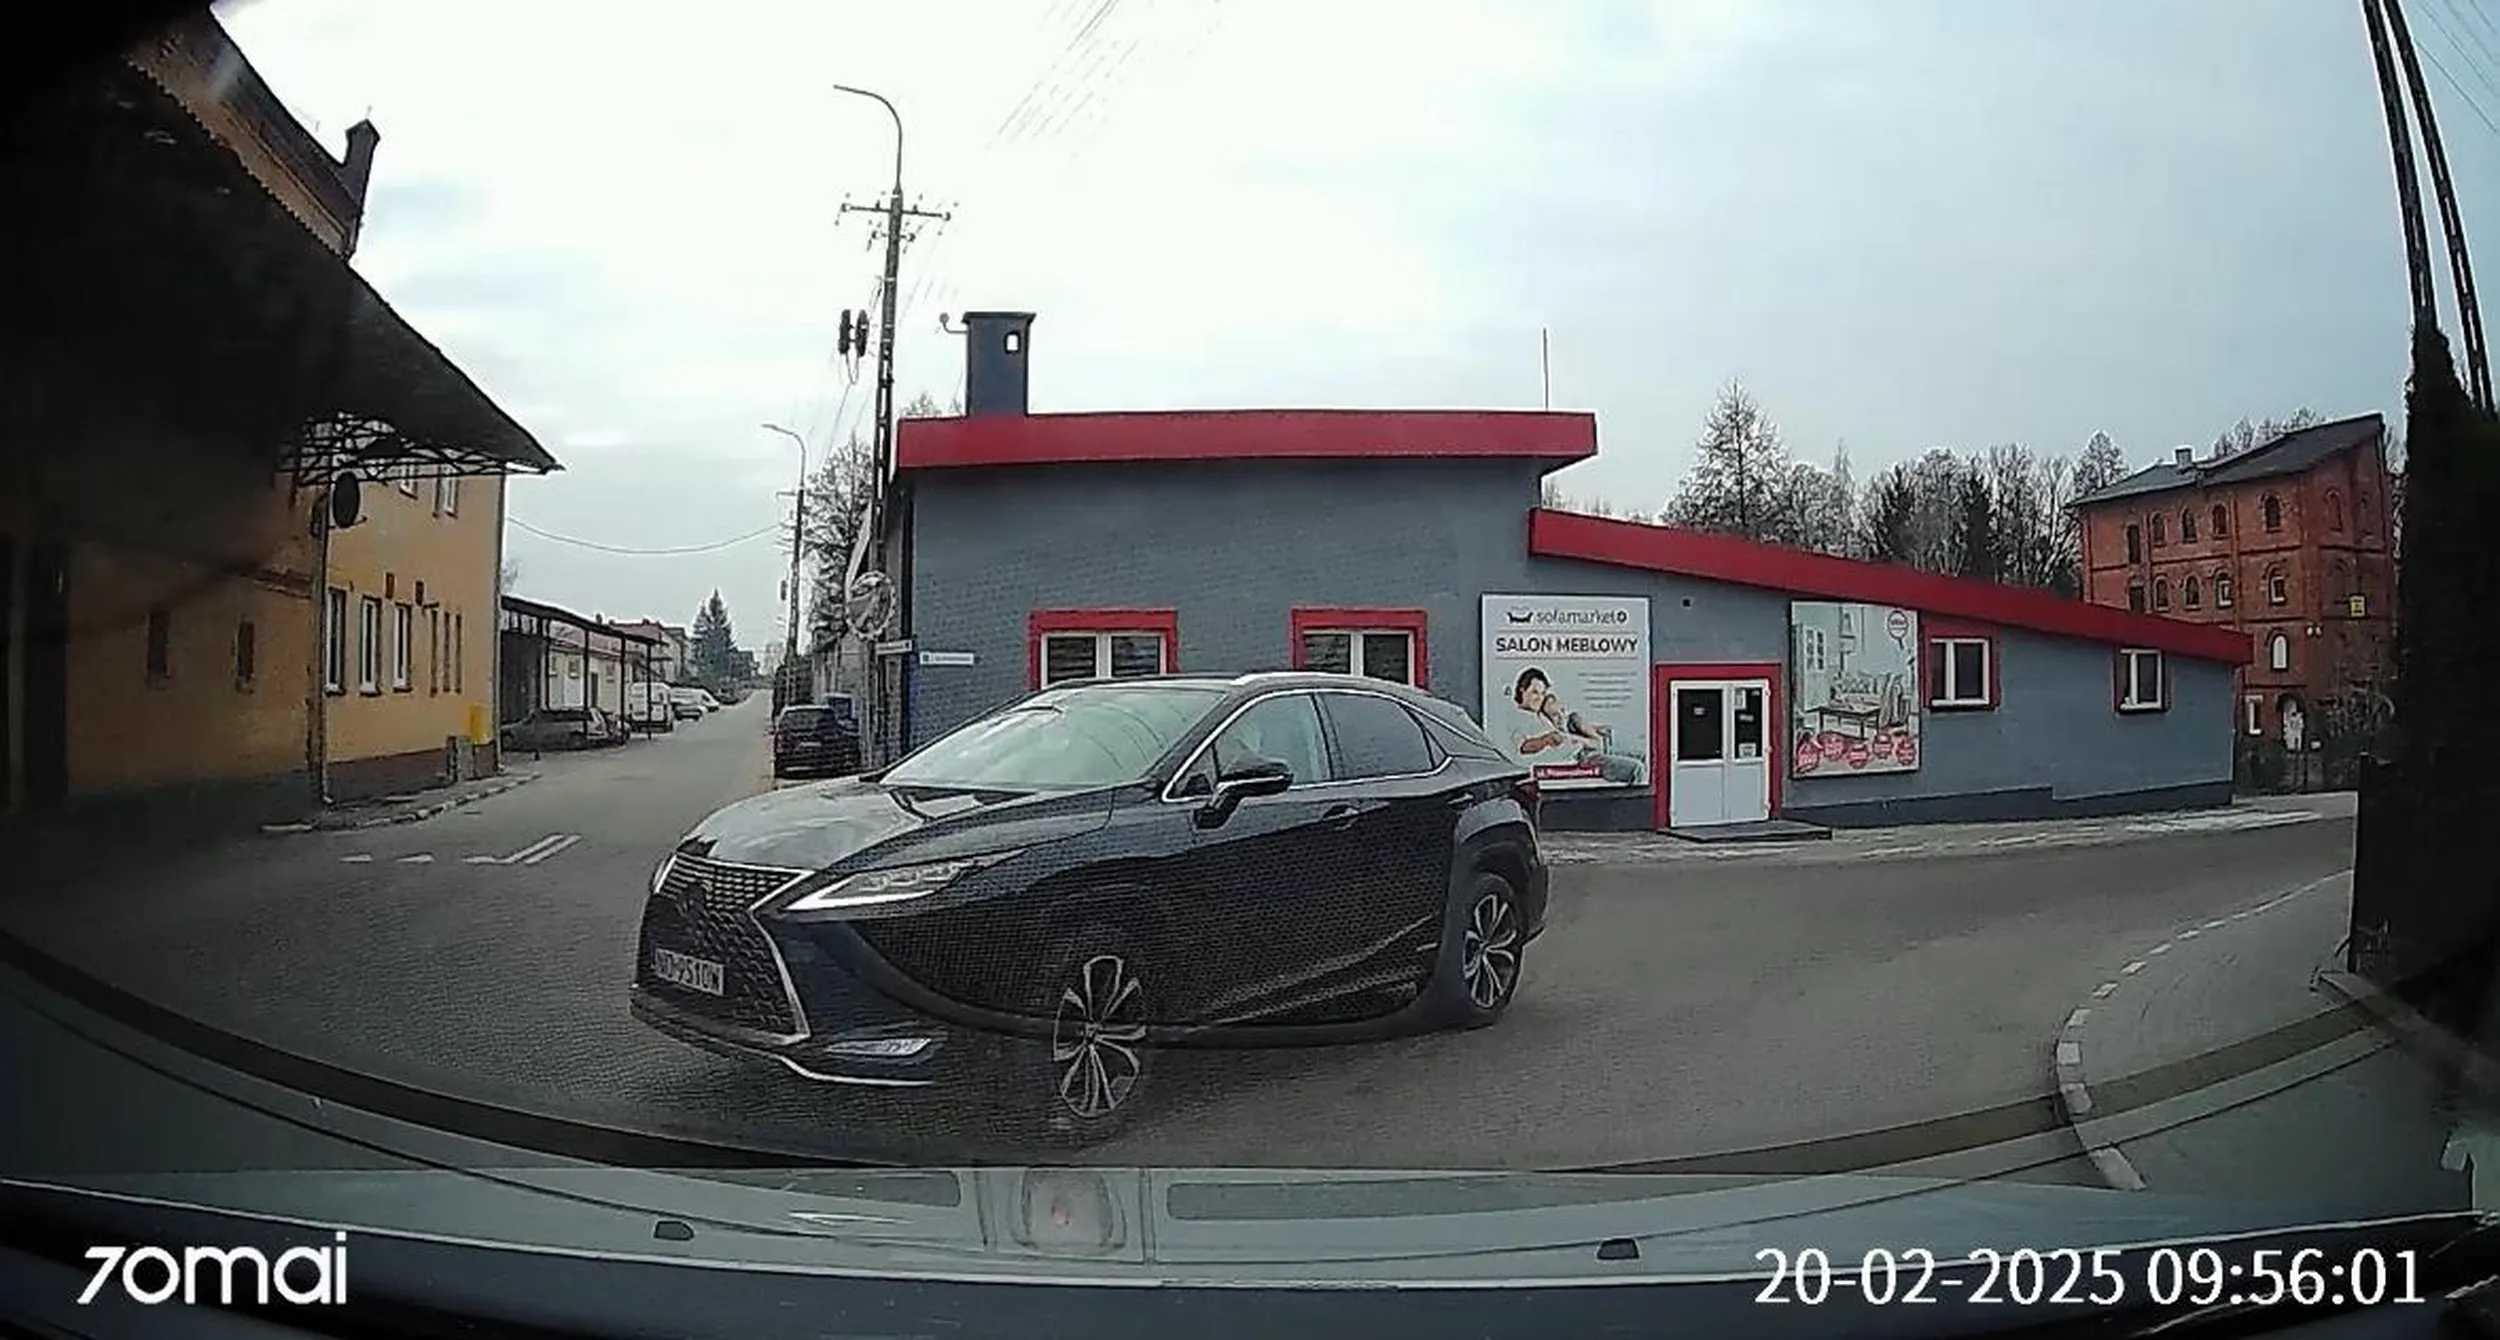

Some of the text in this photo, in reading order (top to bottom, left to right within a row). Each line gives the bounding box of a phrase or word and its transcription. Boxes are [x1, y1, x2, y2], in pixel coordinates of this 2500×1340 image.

[1536, 609, 1615, 624] sofamarket
[1495, 637, 1638, 653] SALON MEBLOWY
